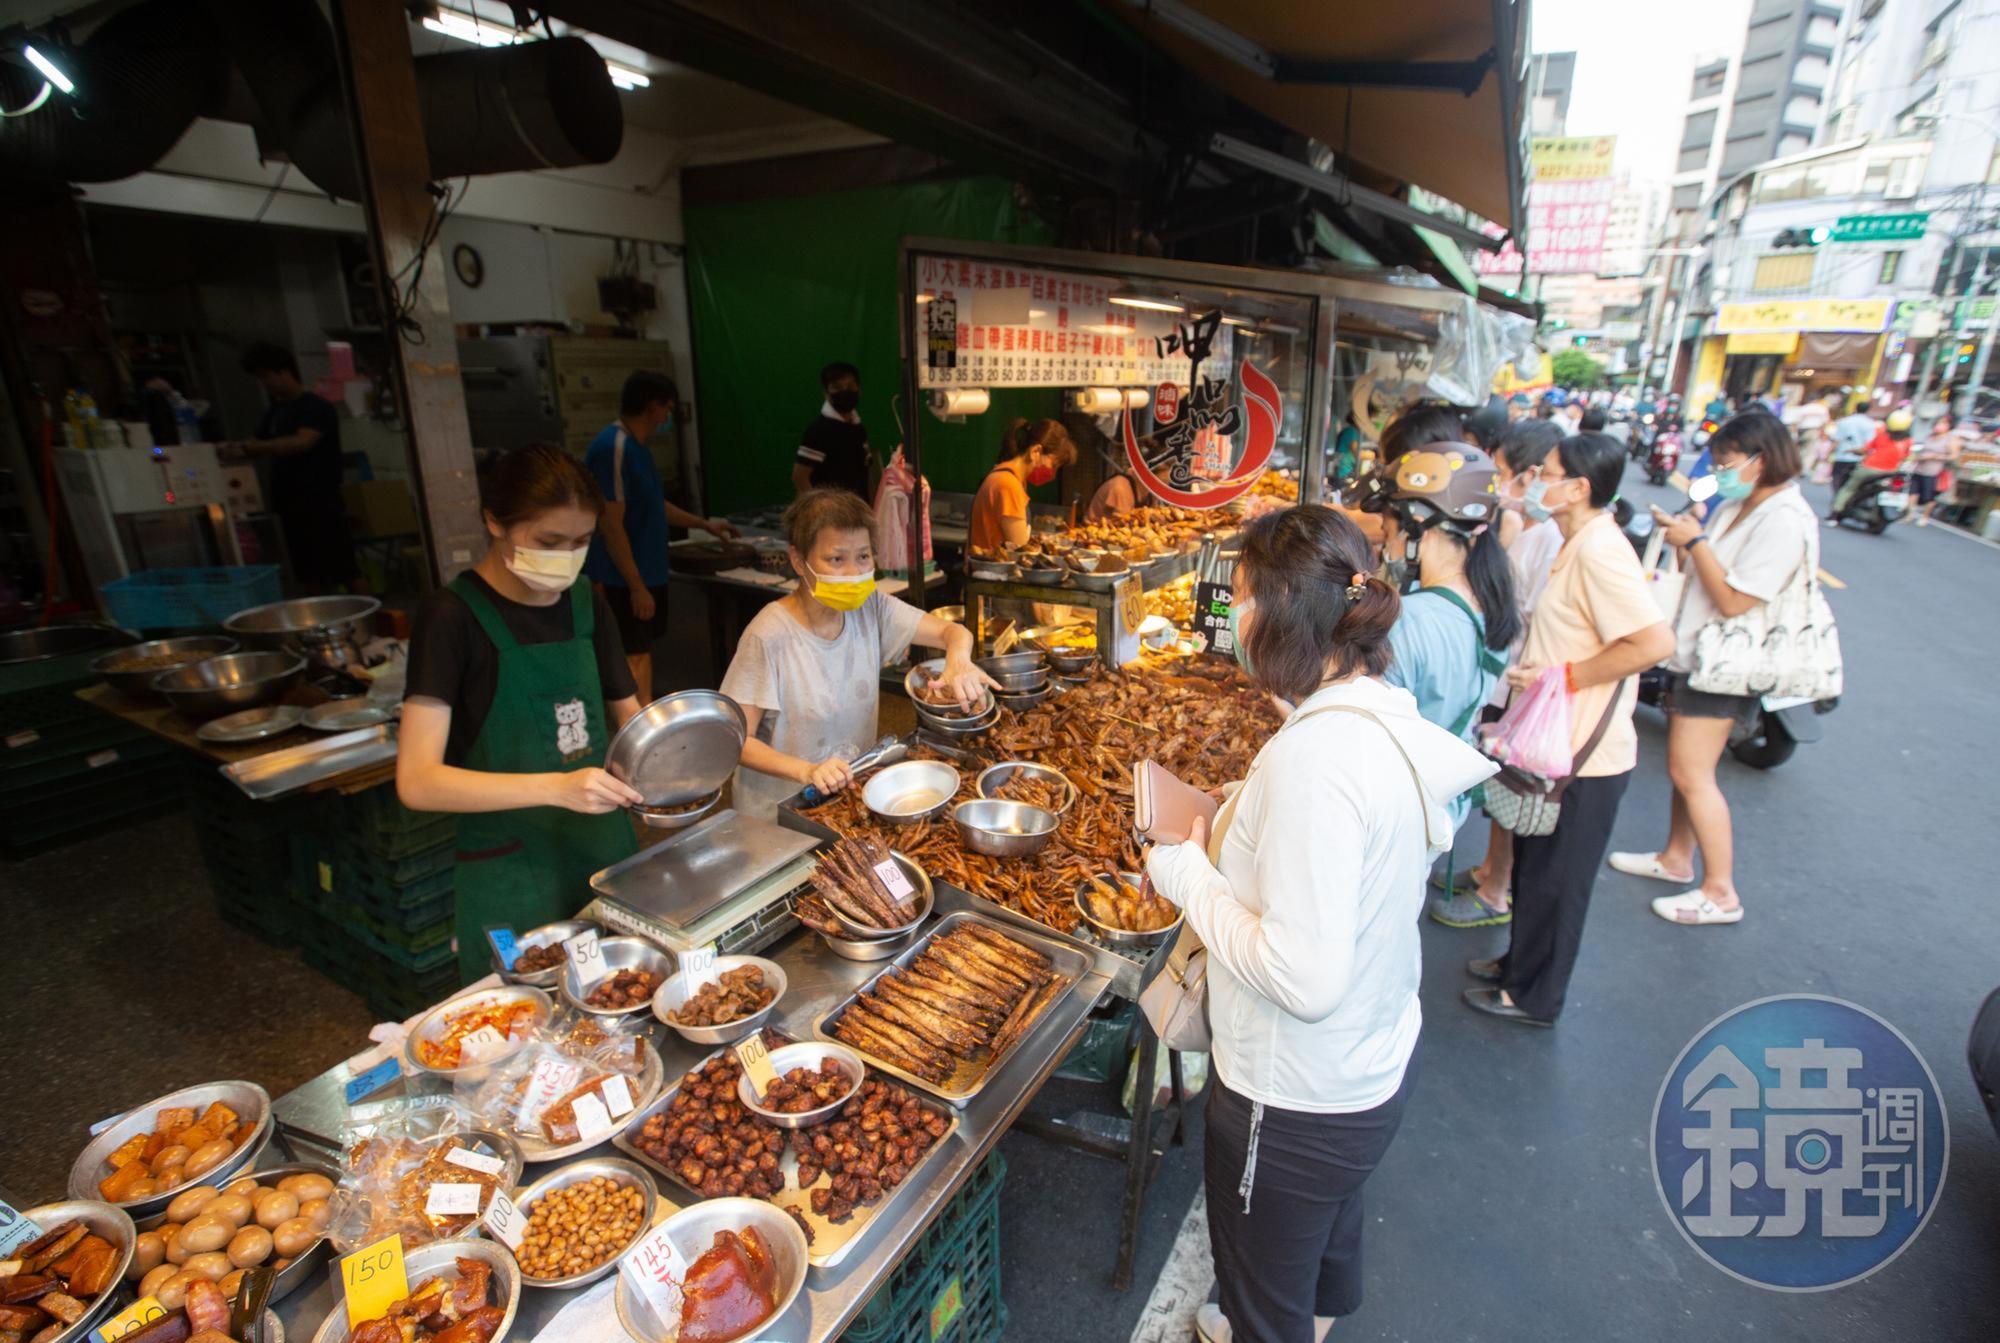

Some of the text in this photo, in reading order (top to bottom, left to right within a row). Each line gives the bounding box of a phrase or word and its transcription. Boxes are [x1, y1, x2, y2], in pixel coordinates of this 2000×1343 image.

[956, 368, 968, 382] 35
[972, 368, 984, 382] 35
[987, 368, 999, 382] 20
[1002, 368, 1014, 382] 50
[1016, 368, 1028, 382] 20
[1212, 588, 1233, 604] Ub
[576, 939, 600, 964] 50
[686, 950, 713, 972] 100
[741, 1039, 765, 1068] 100
[537, 1062, 578, 1088] 250
[488, 1196, 515, 1234] 100
[349, 1250, 393, 1286] 150
[632, 1236, 672, 1277] 145
